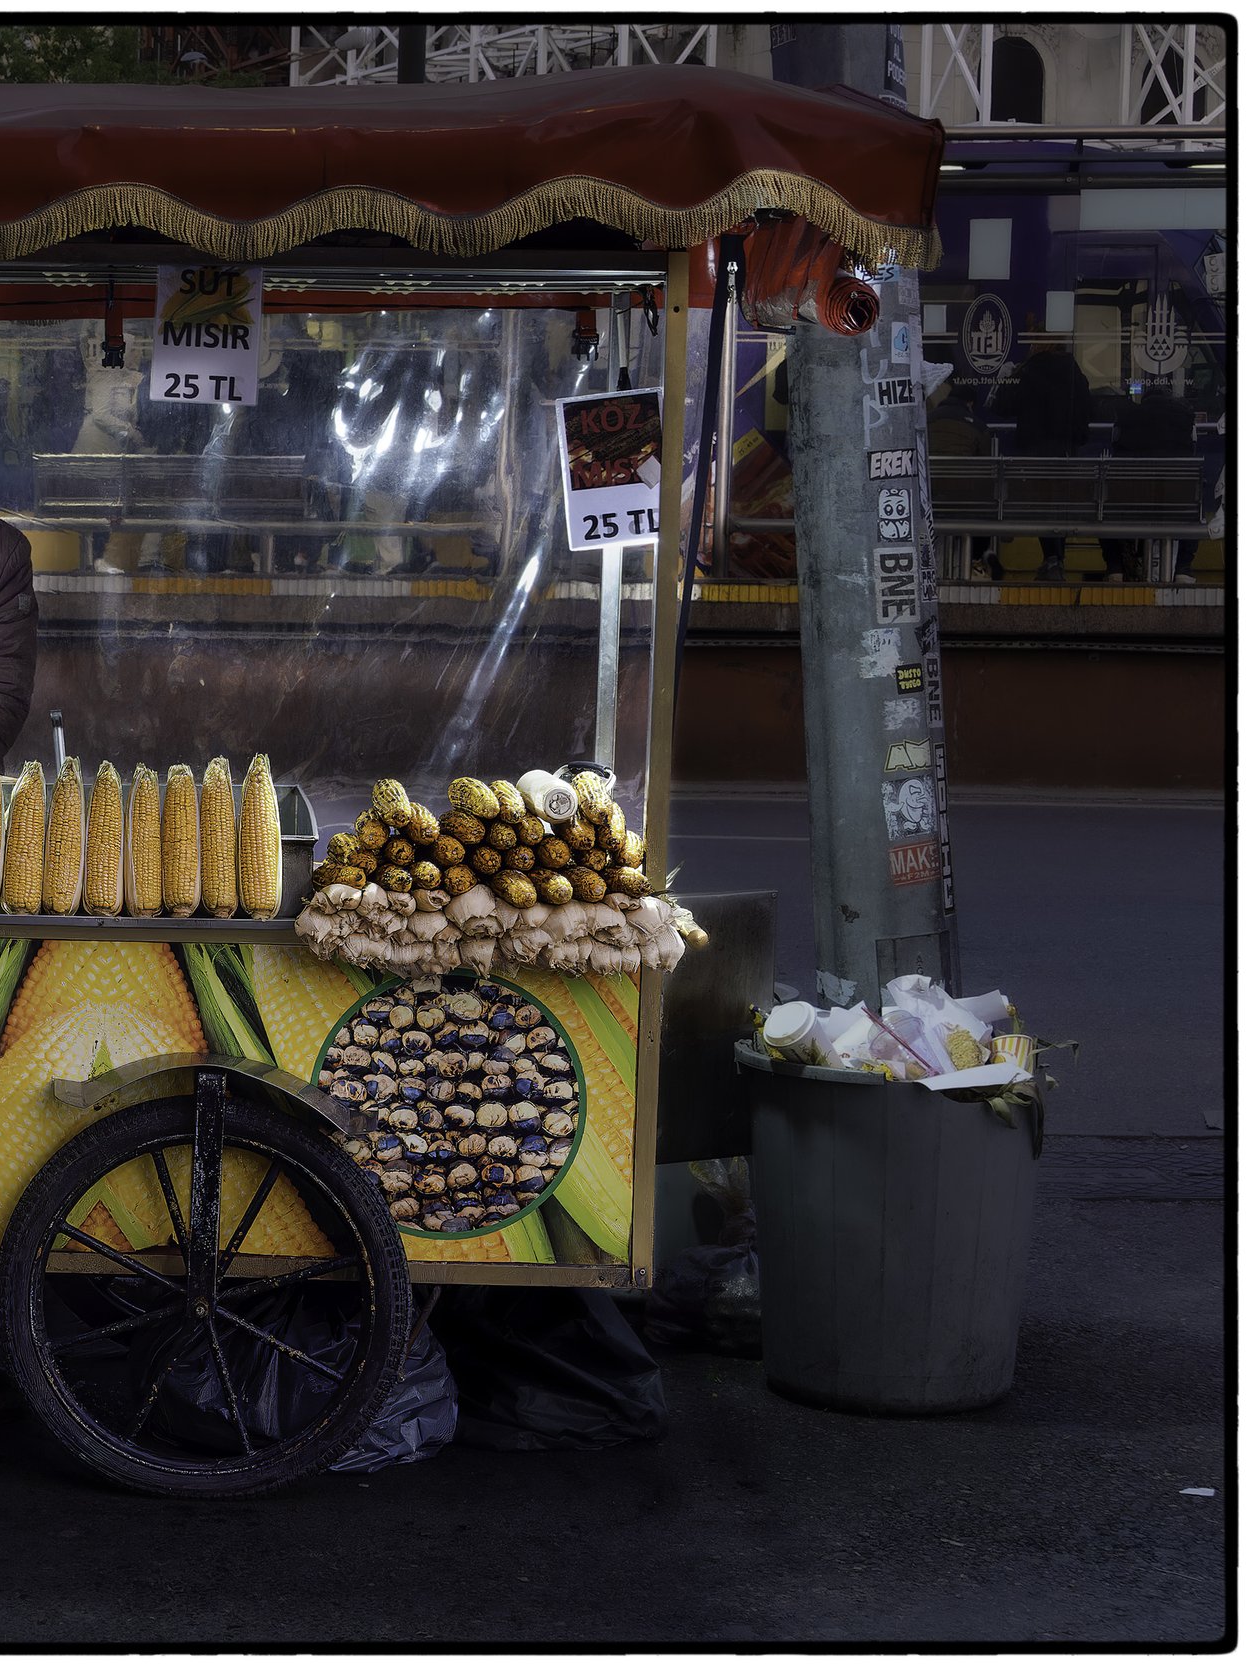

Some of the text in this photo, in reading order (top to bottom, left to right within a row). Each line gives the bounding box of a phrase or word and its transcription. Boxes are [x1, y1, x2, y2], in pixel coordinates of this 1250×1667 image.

[180, 266, 239, 296] SÜT
[162, 320, 250, 350] MISIR
[163, 373, 242, 401] 25 TL
[580, 400, 642, 434] KÖZ
[583, 509, 660, 540] 25 TL
[879, 553, 917, 618] BNE
